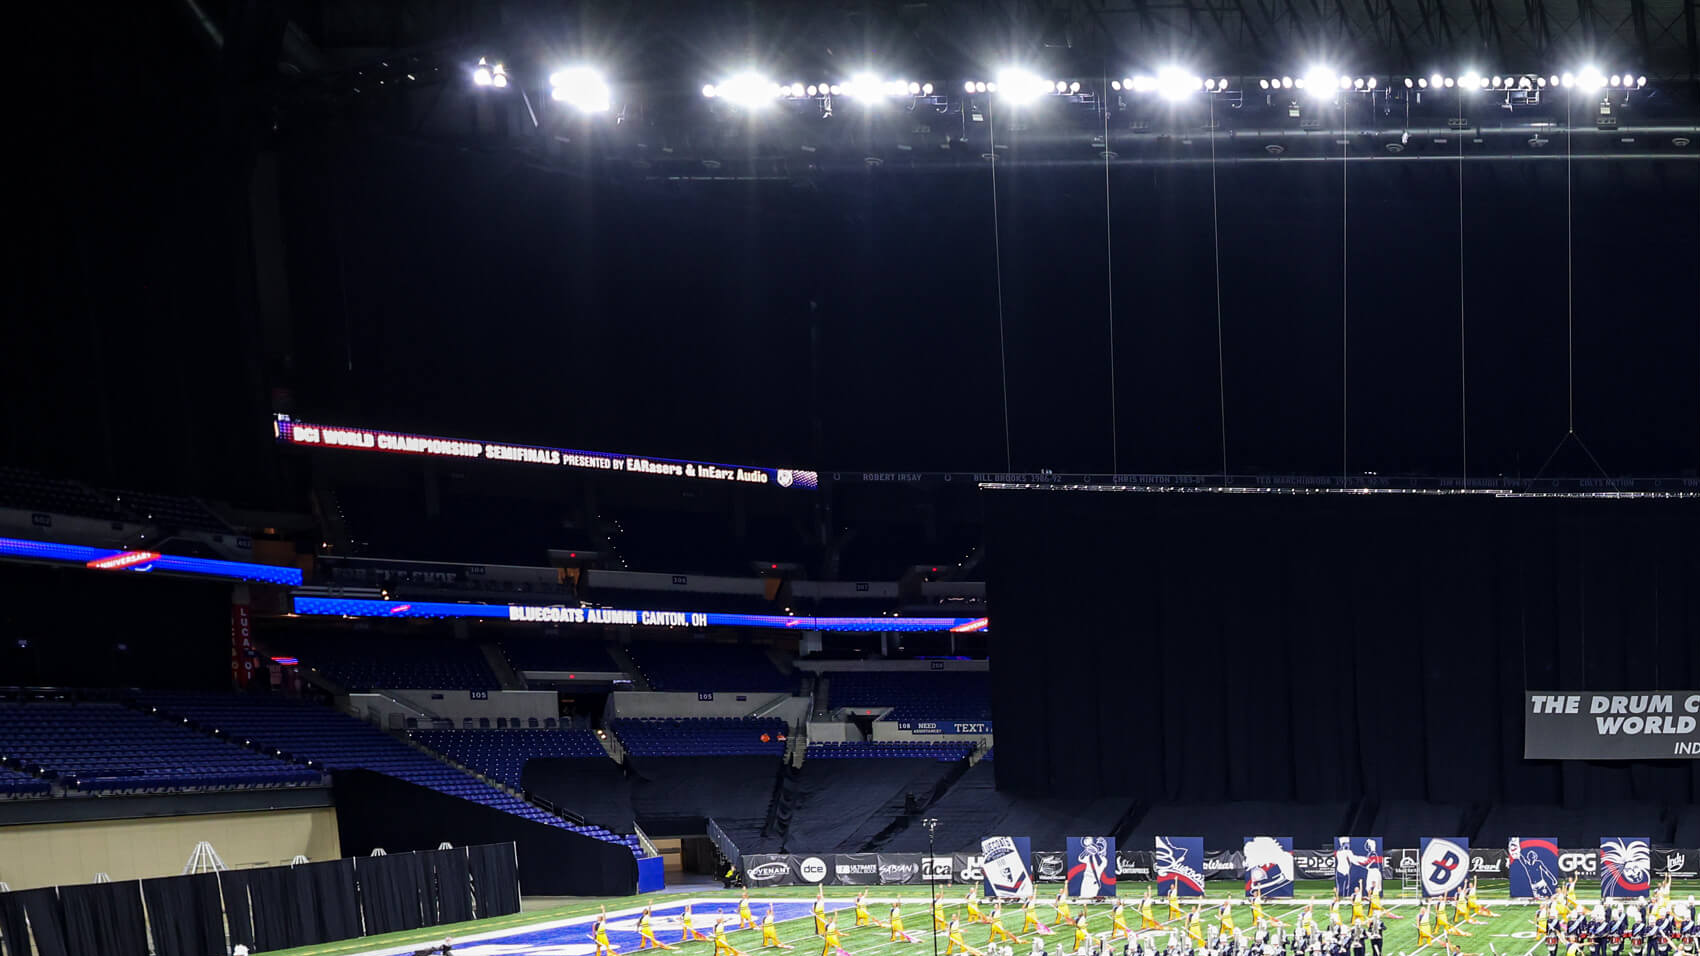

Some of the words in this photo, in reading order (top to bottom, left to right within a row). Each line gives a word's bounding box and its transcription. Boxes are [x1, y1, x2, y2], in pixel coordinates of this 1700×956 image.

[322, 429, 374, 448] WORLD
[377, 434, 482, 457] CHAMPIONSHIP
[485, 444, 560, 465] SEMIFINALS
[563, 455, 611, 470] PRESENTED
[613, 459, 624, 470] BY
[626, 458, 682, 476] EARasers
[686, 463, 696, 478] &
[698, 465, 734, 480] InEarz
[737, 468, 768, 483] Audio
[863, 473, 897, 481] ROBERT
[509, 606, 585, 623] BLUECOATS
[587, 609, 638, 625] ALUMNI
[642, 610, 689, 627] CANTON,
[692, 612, 708, 627] OH
[1531, 695, 1581, 714] THE
[1590, 695, 1673, 714] DRUM
[954, 724, 984, 733] TEXT
[1595, 716, 1696, 735] WORLD
[804, 864, 824, 874] dce
[1471, 856, 1501, 873] Pearl
[1560, 853, 1596, 871] GPG
